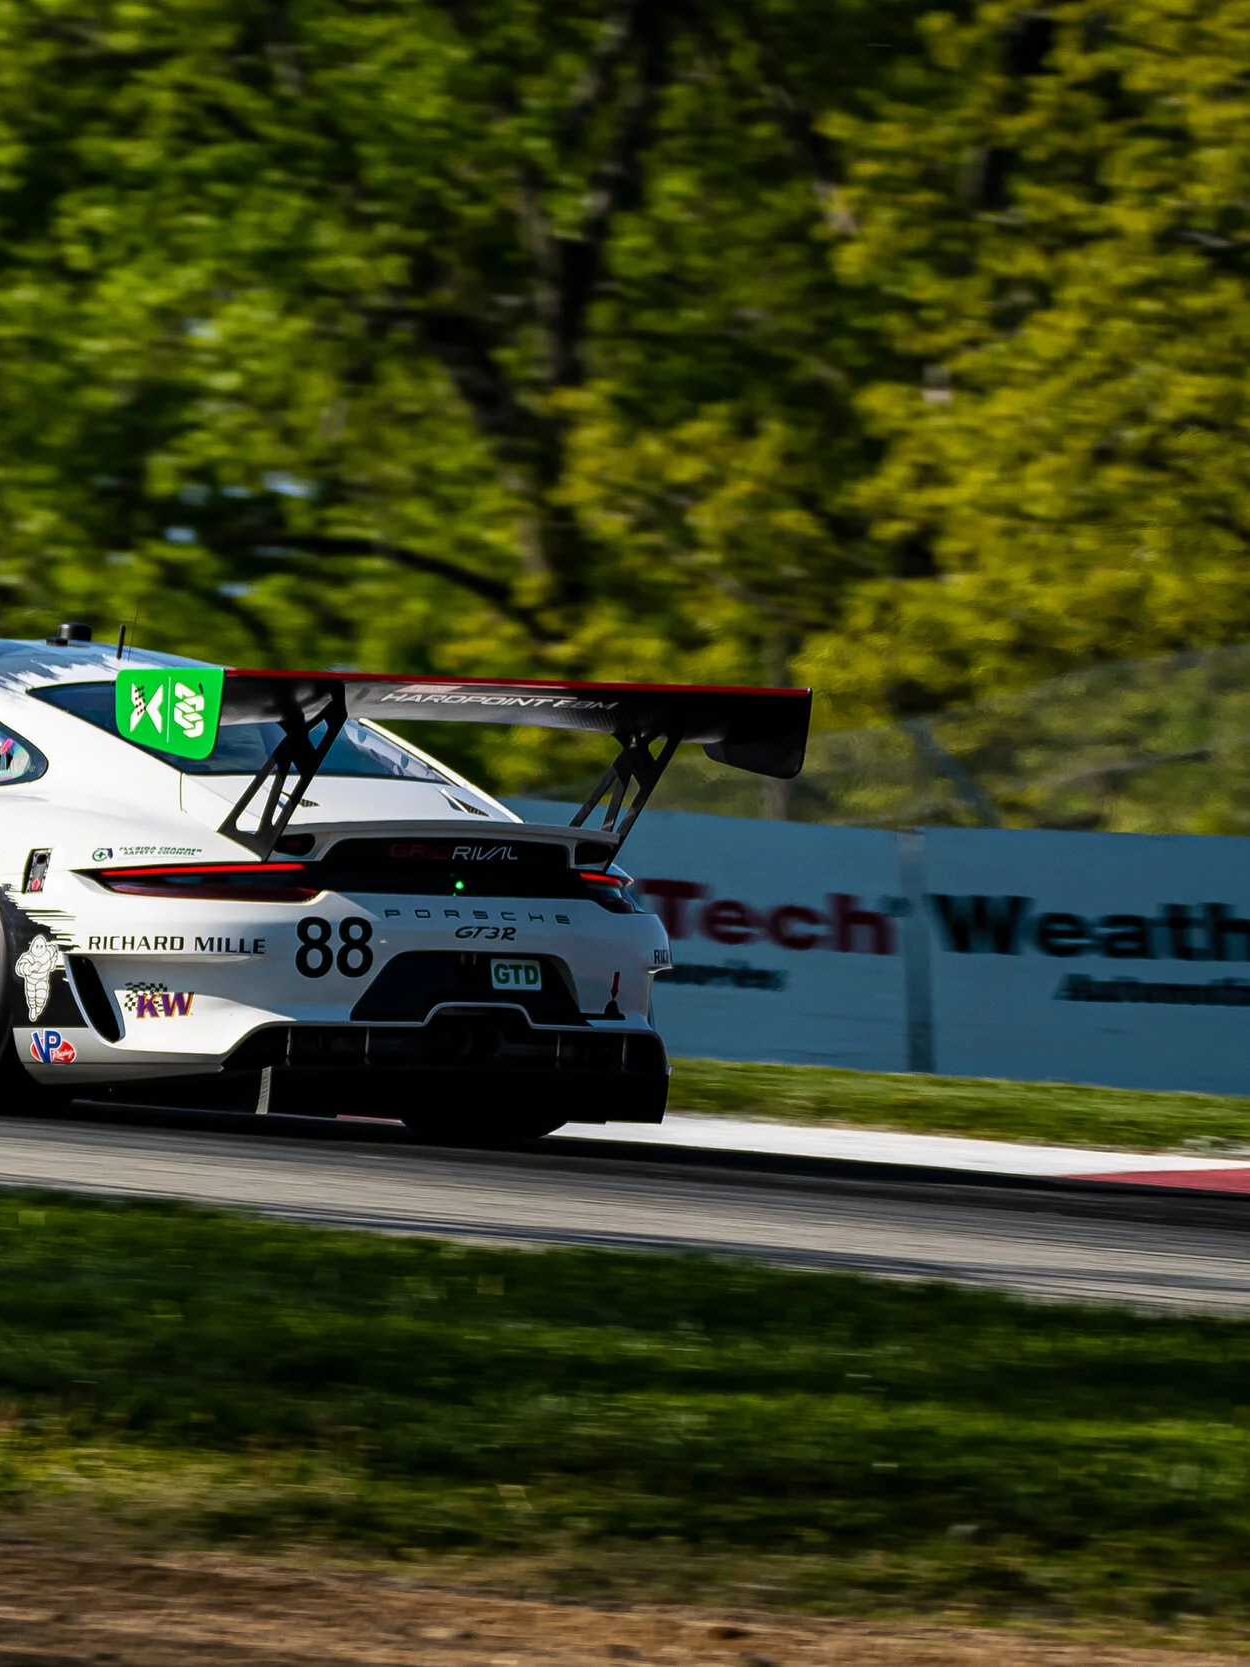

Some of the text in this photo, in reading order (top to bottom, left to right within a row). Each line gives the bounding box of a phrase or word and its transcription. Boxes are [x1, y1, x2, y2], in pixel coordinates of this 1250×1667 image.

[383, 909, 572, 925] PORSCHE
[636, 878, 898, 956] Tech
[88, 936, 267, 955] RICHARD MILLE
[295, 916, 374, 978] 88
[493, 963, 540, 985] GTD
[136, 991, 196, 1019] KW
[31, 1029, 62, 1064] VP
